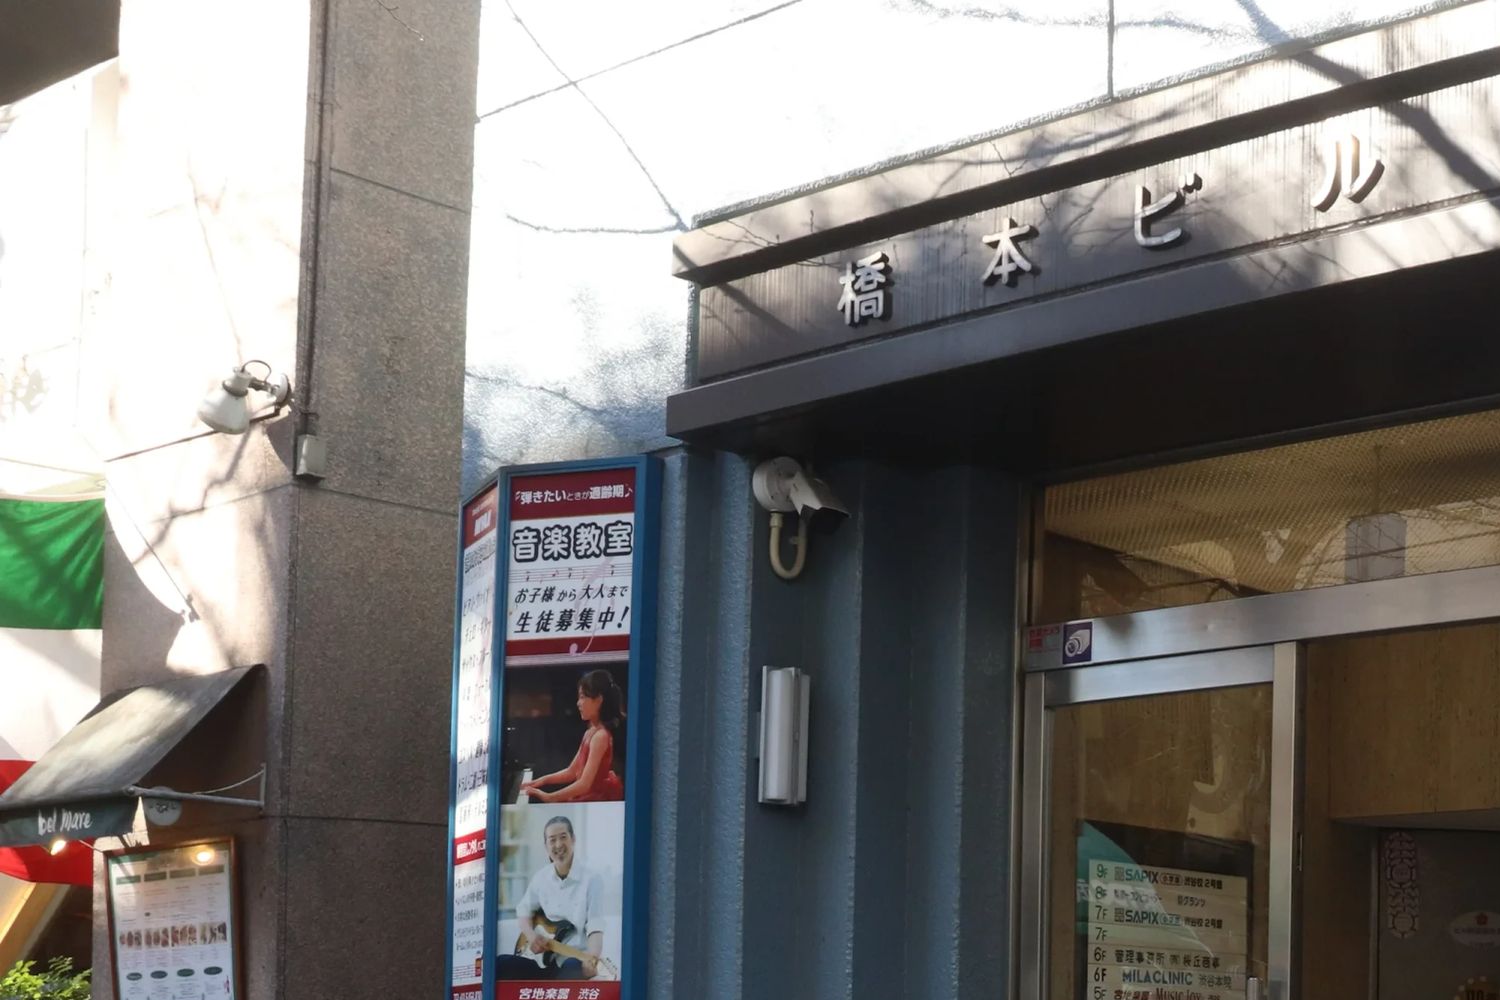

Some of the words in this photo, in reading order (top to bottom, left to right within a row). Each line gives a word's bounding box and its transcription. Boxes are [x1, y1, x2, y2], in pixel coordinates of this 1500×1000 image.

[838, 133, 1386, 325] 橋本ビル
[512, 520, 633, 563] 音楽教室
[514, 583, 629, 605] お子様から大人まで
[38, 808, 58, 836] bel
[1096, 863, 1108, 879] 9F
[1125, 868, 1159, 885] SAPIX
[1095, 885, 1107, 900] 8F
[1095, 905, 1108, 919] 7F
[1125, 909, 1159, 925] SAPIX
[1094, 926, 1107, 941] 7F
[1094, 949, 1107, 962] 6F
[1094, 967, 1107, 983] 6F
[518, 987, 570, 1000] 宮地楽器
[577, 987, 600, 1000] 渋谷
[1094, 986, 1107, 999] 5F
